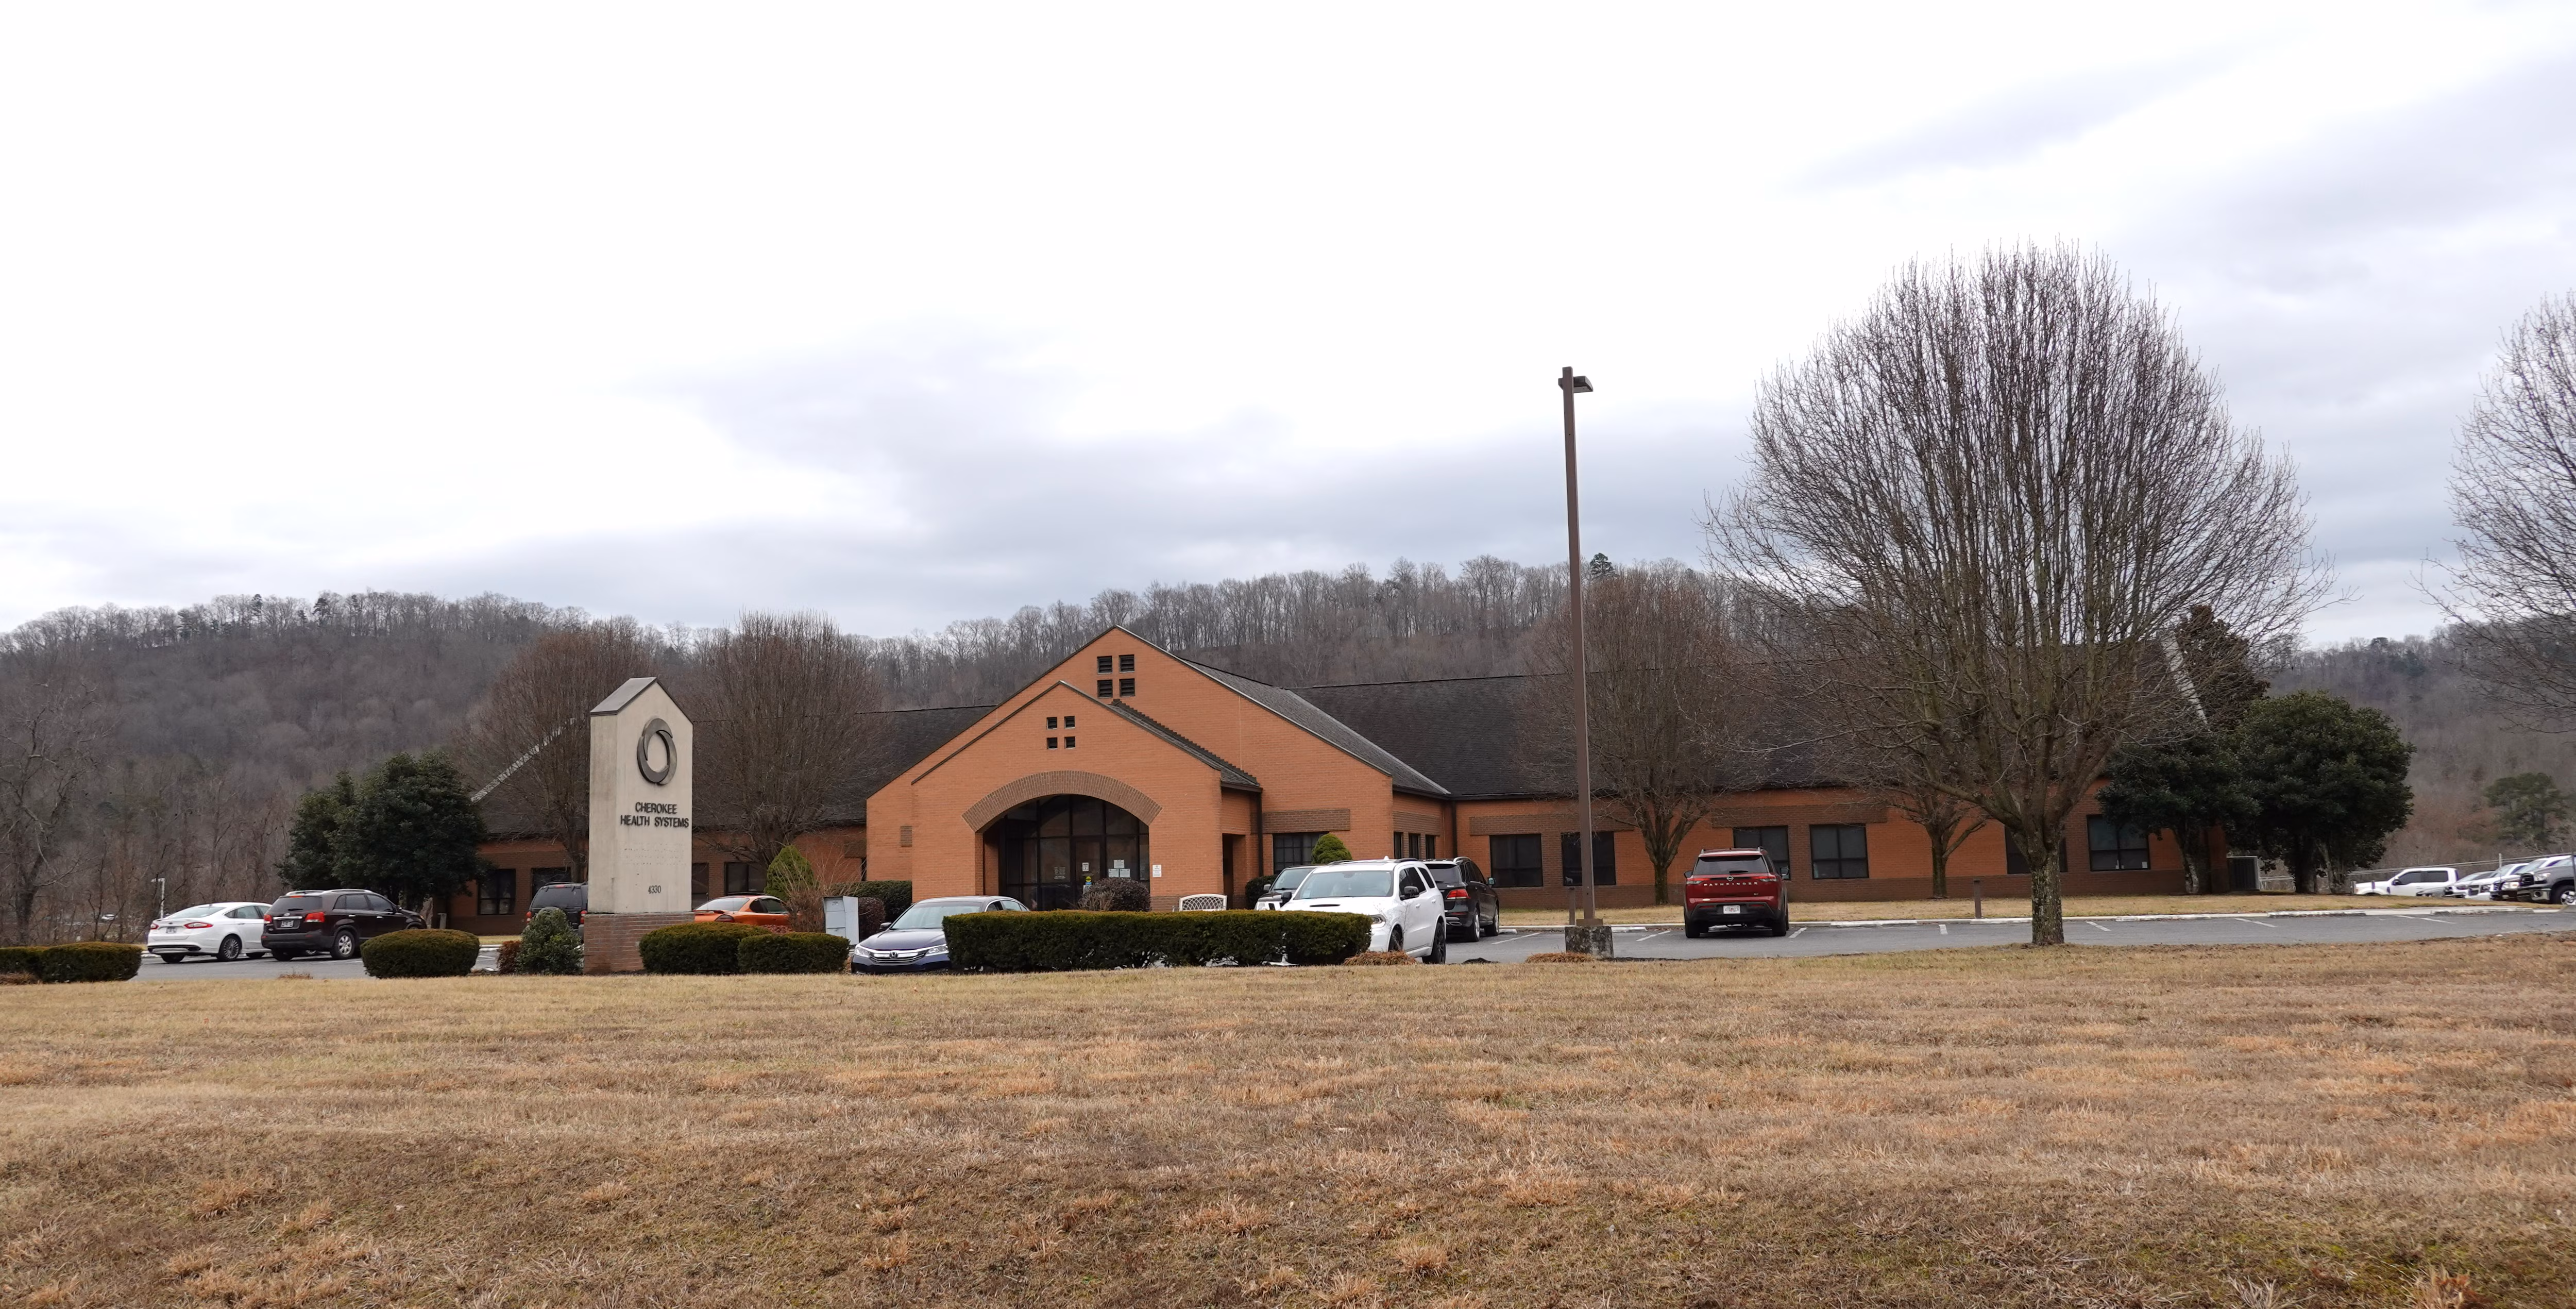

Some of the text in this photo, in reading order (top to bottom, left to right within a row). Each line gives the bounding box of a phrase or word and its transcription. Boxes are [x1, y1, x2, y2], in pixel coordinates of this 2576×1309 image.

[635, 802, 677, 814] CHEROKEE
[620, 815, 689, 828] HEALTH SYSTEMS
[648, 885, 662, 894] 4330
